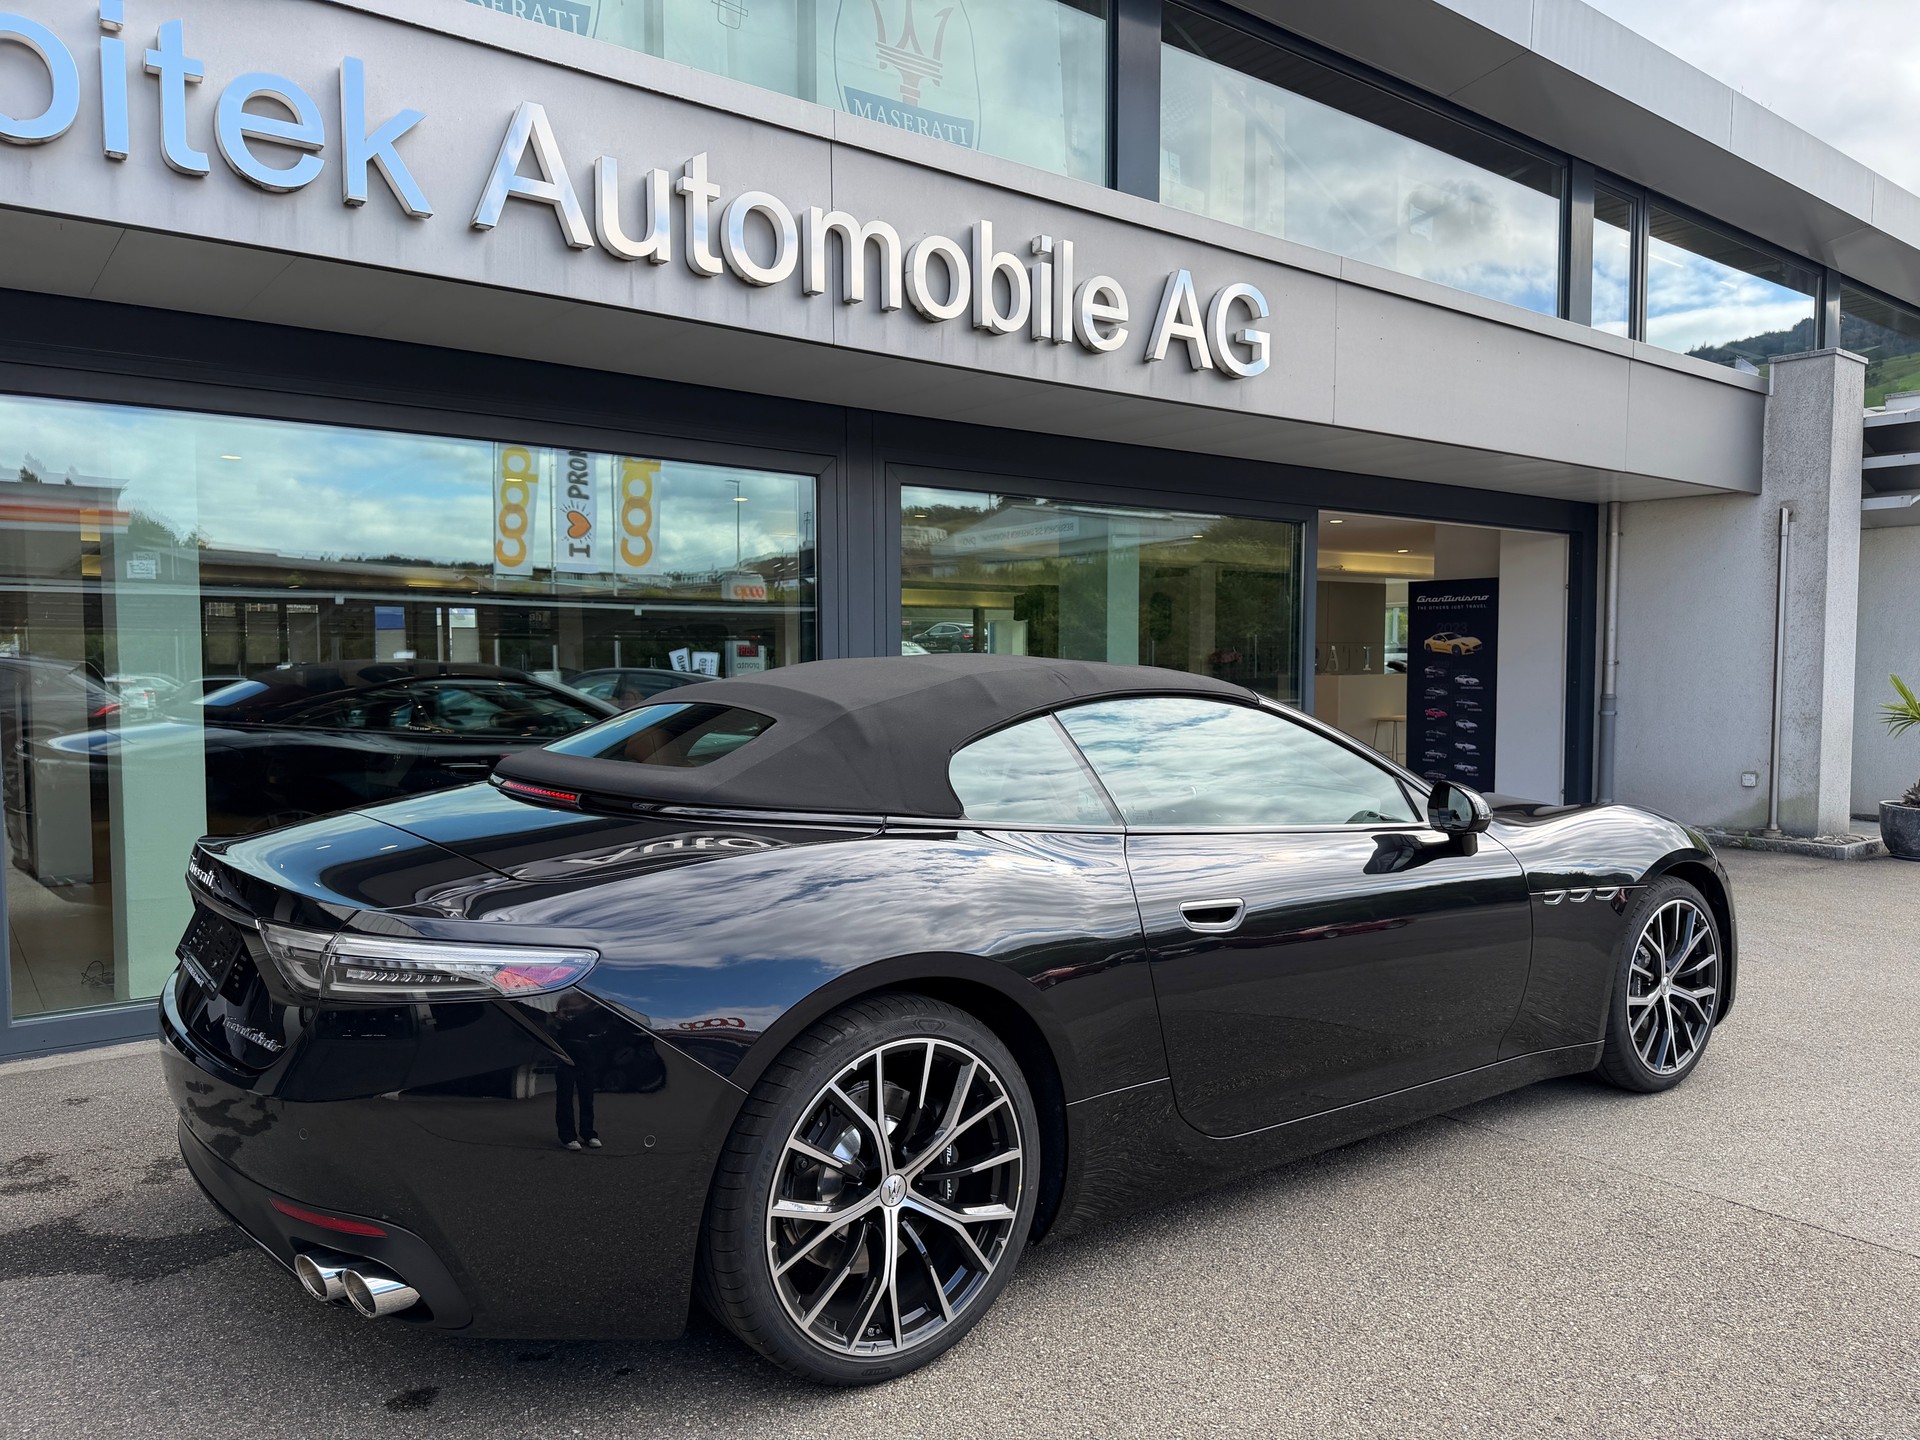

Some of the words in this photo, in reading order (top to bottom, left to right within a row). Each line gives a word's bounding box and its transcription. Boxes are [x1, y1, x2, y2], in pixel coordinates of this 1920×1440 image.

[853, 98, 969, 146] MASERATI
[470, 100, 1130, 354] Automobile
[1142, 268, 1271, 379] AG
[495, 446, 539, 567] coop
[945, 1144, 953, 1200] Marati
